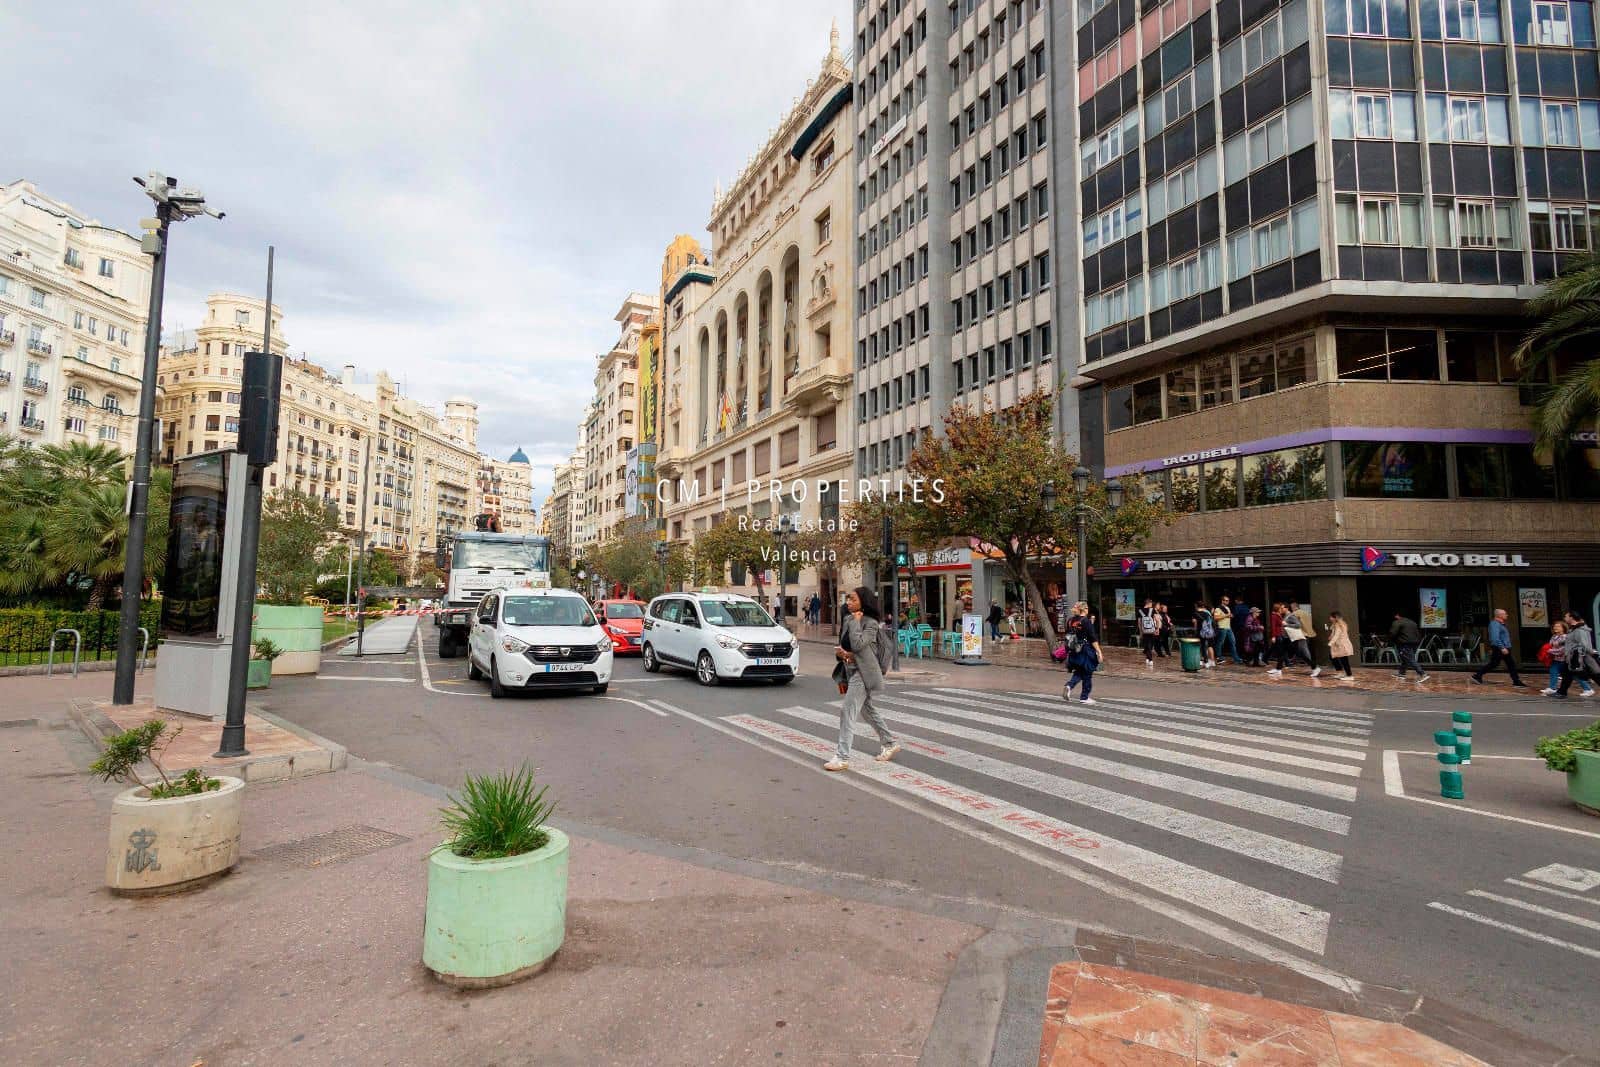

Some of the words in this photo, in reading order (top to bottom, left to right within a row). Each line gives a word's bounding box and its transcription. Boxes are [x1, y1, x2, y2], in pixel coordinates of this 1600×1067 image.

[1162, 453, 1199, 466] TACO
[1200, 446, 1242, 460] BELL
[1143, 558, 1198, 572] TACO
[1200, 556, 1261, 570] BELL
[1391, 553, 1460, 567] TACO
[1463, 553, 1530, 567] BELL
